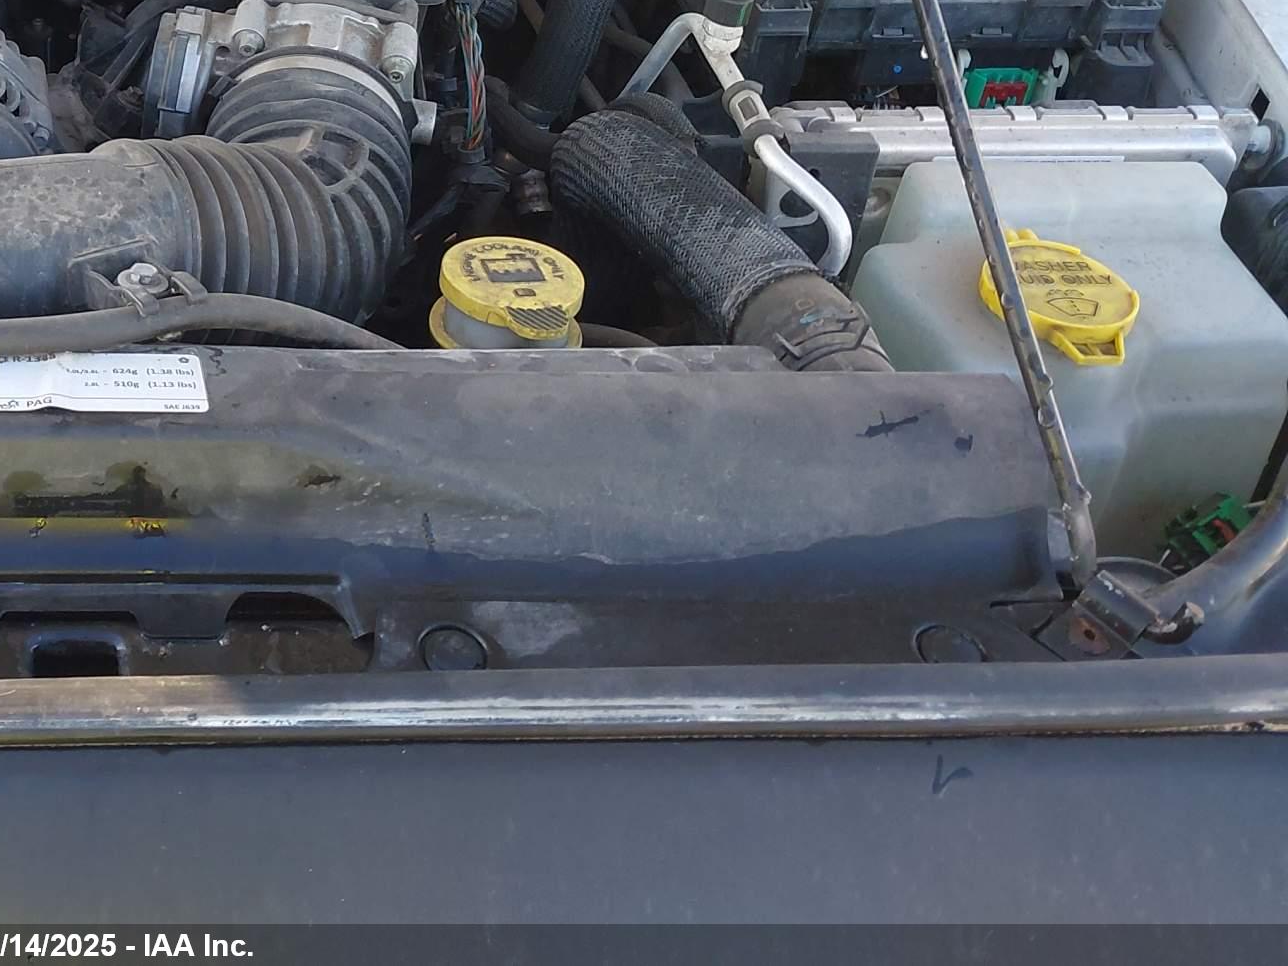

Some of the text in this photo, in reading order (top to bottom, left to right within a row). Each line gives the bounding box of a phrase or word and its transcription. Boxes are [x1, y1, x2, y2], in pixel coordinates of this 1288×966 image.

[473, 242, 541, 256] COOLANT
[543, 256, 565, 280] ONLY
[1061, 274, 1112, 285] ONLY
[112, 367, 139, 375] 624g
[175, 368, 194, 376] lbs)
[113, 380, 141, 389] 510g
[148, 381, 175, 389] (1.13
[177, 381, 197, 390] lbs)
[26, 396, 53, 408] PAG
